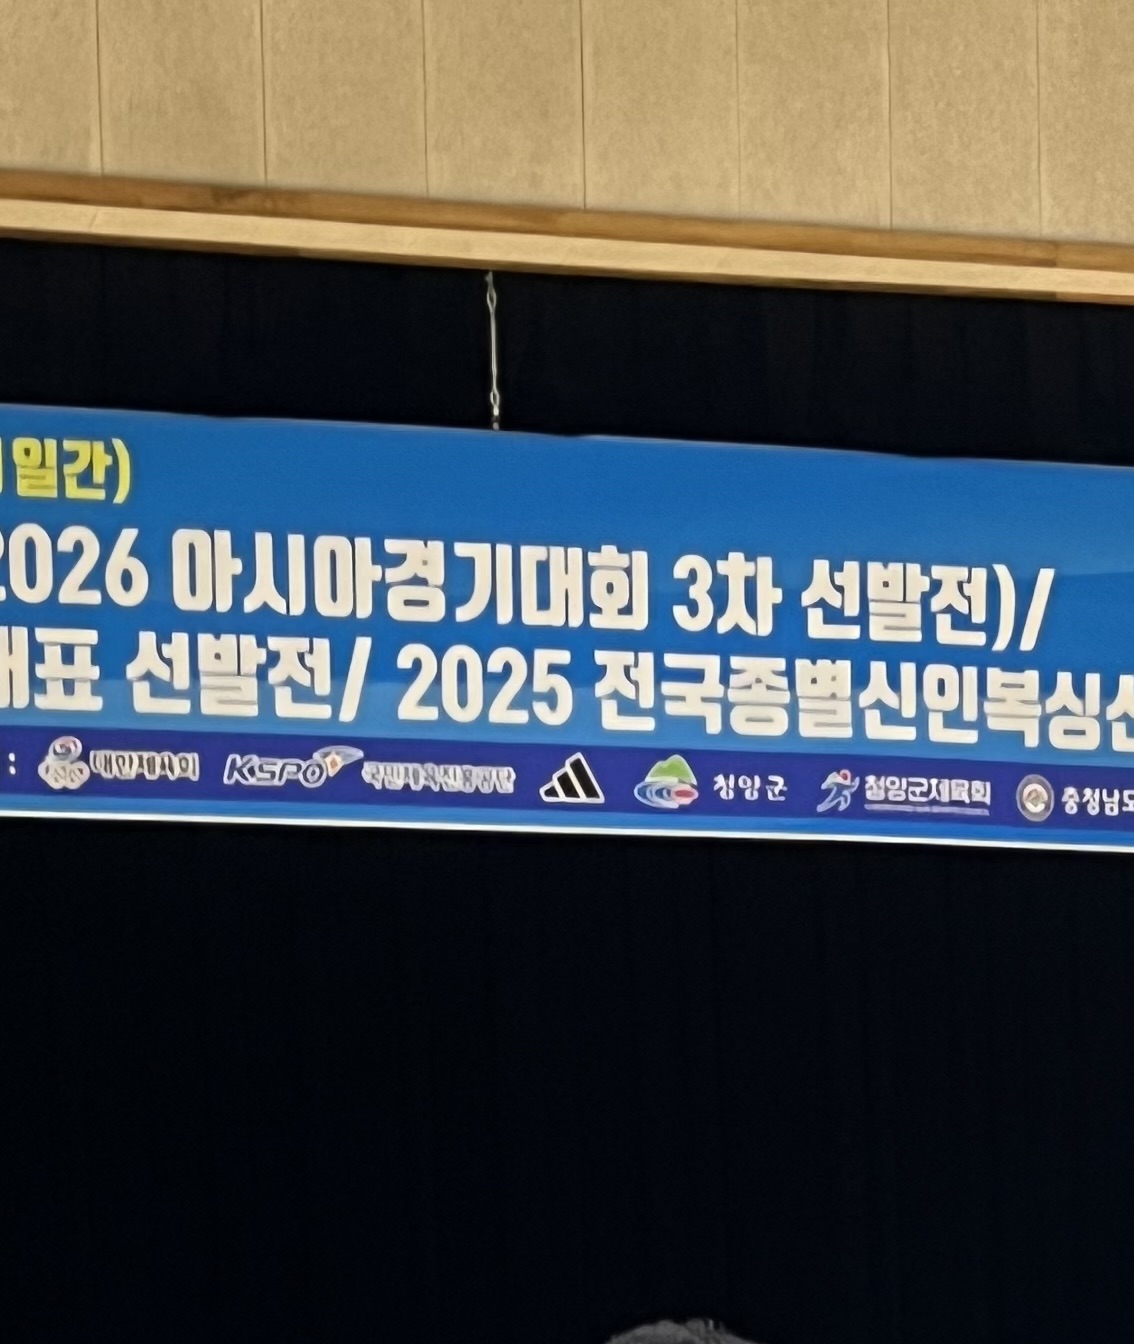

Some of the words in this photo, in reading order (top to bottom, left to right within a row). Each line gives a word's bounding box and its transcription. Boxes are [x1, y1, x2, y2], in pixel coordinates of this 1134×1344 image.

[0, 437, 131, 504] 일간)
[0, 522, 149, 607] 026
[171, 528, 649, 631] 아시아경기대회
[671, 553, 783, 638] 3차
[800, 559, 1056, 653] 선발전)/
[126, 631, 372, 723] 선발전/
[397, 645, 574, 725] 2025
[223, 754, 326, 788] KSPO
